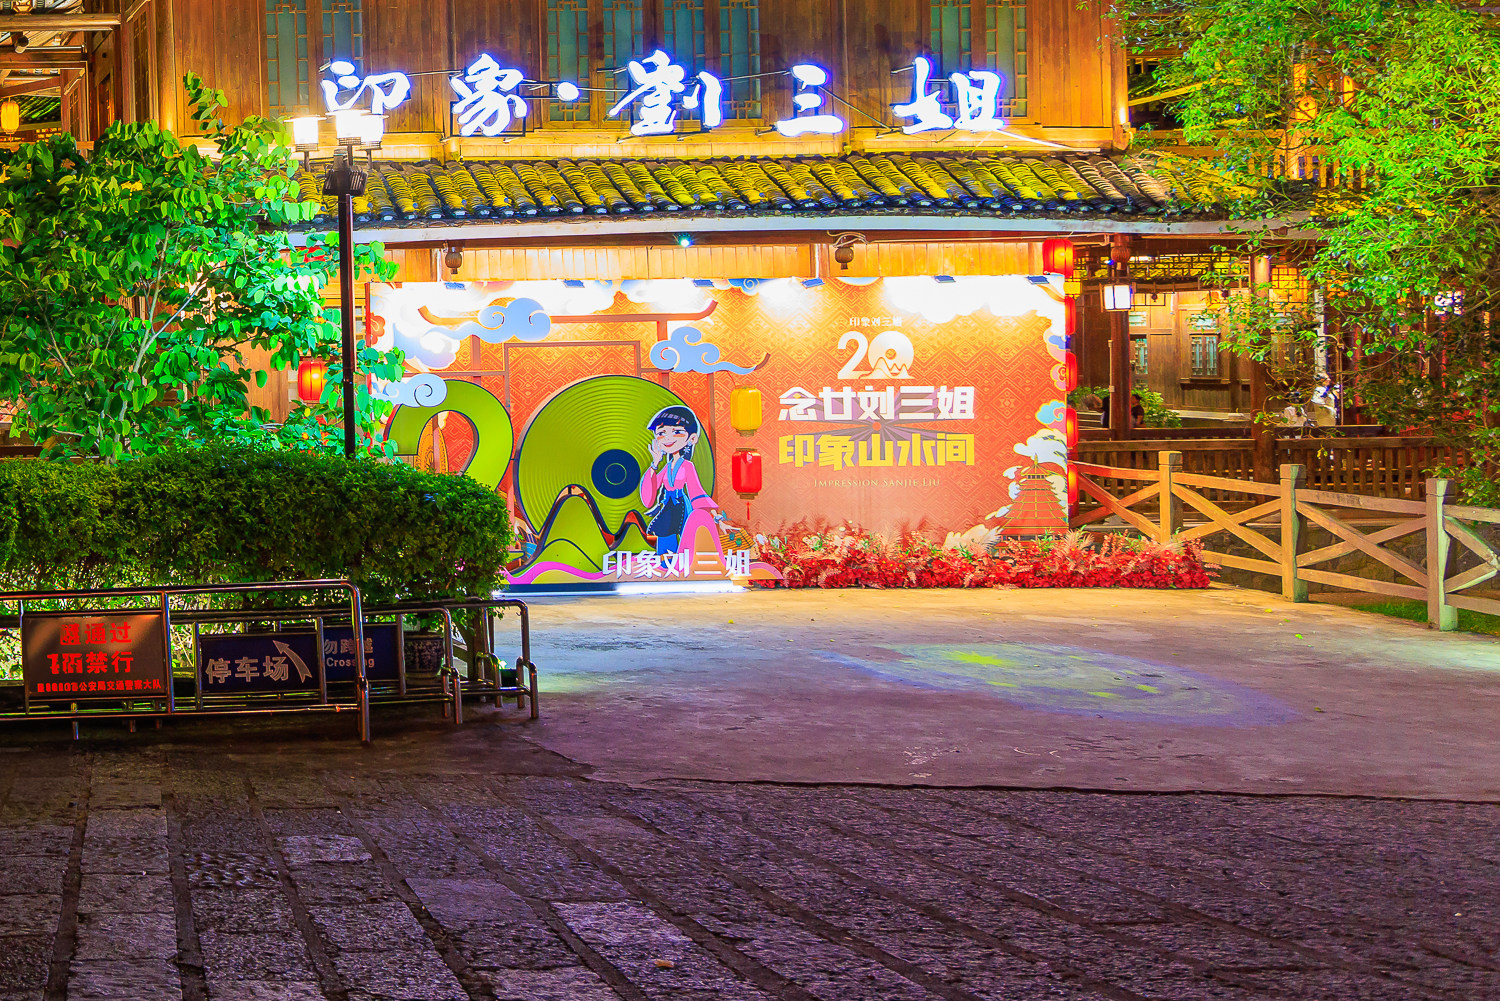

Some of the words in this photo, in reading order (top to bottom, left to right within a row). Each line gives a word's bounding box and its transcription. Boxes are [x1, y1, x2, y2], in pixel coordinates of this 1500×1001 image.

[849, 317, 902, 327] 印象刘三姐
[778, 386, 975, 420] 念廿刘三姐
[778, 433, 975, 471] 印象山水间
[602, 548, 751, 579] 印象刘三姐
[205, 655, 289, 684] 停车场
